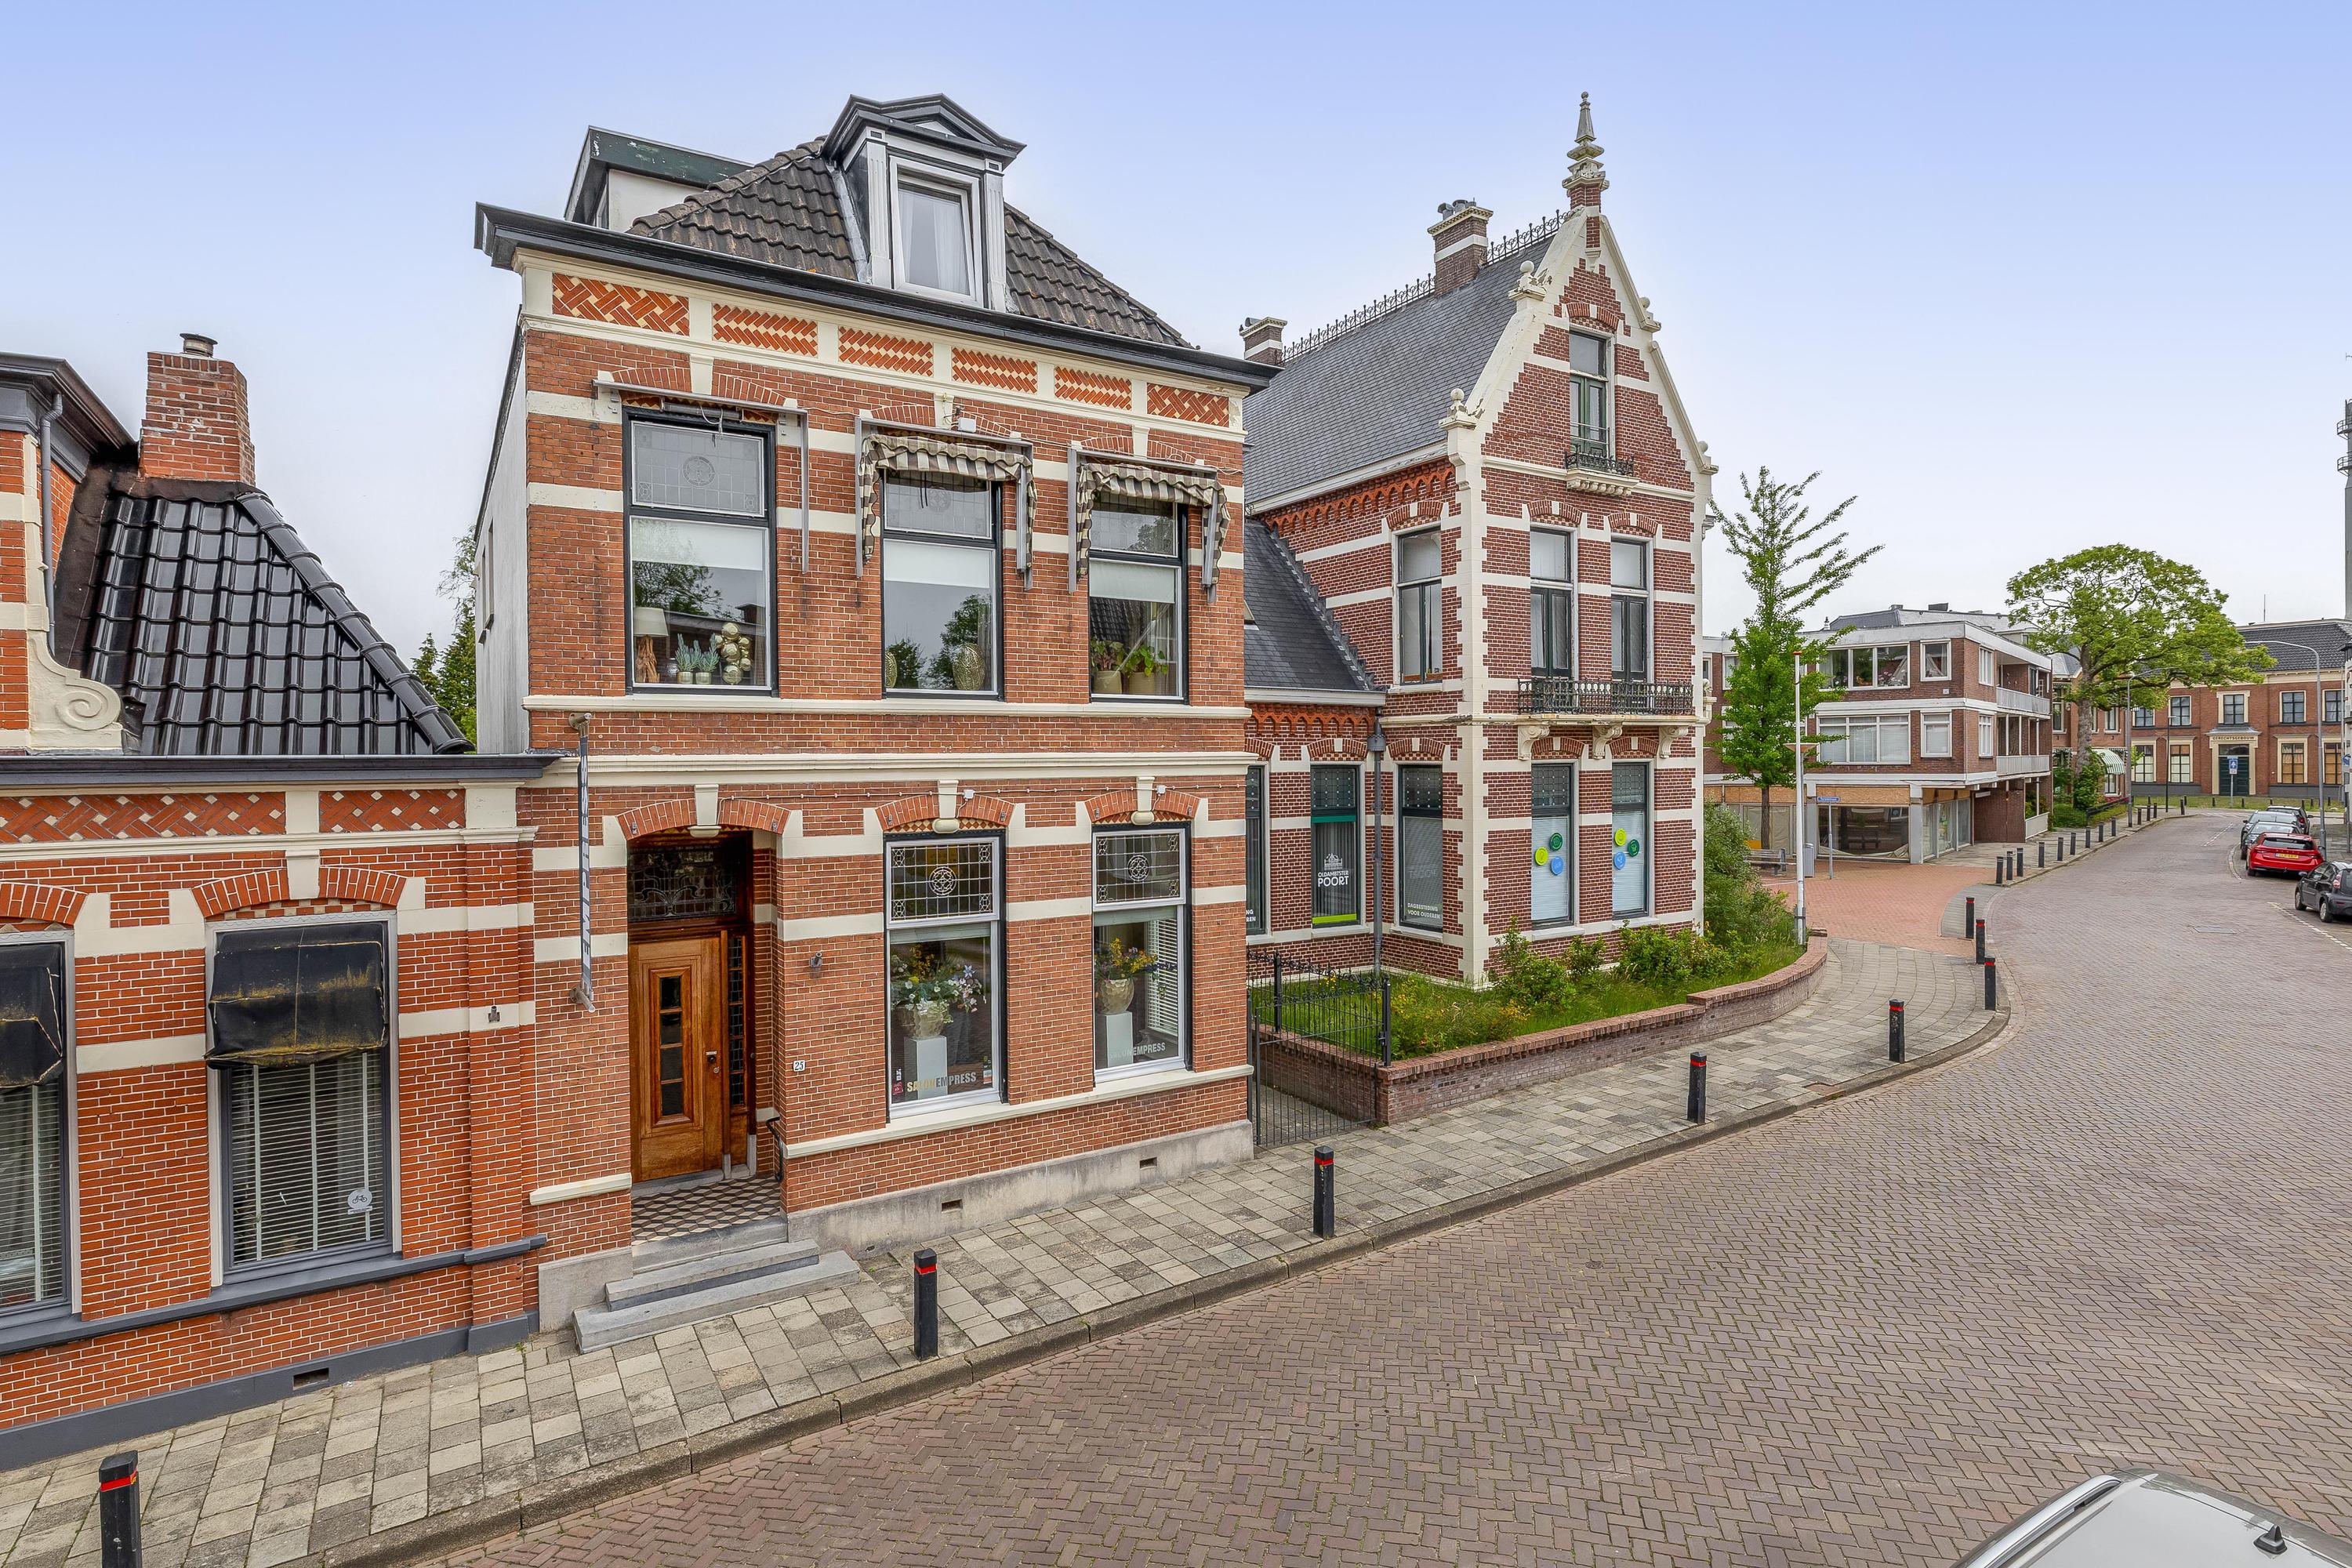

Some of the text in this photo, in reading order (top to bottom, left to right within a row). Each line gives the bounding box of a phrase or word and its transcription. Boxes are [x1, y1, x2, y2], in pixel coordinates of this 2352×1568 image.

[581, 754, 590, 968] EMPRESS
[1318, 876, 1349, 887] POORT
[794, 1061, 804, 1071] 25
